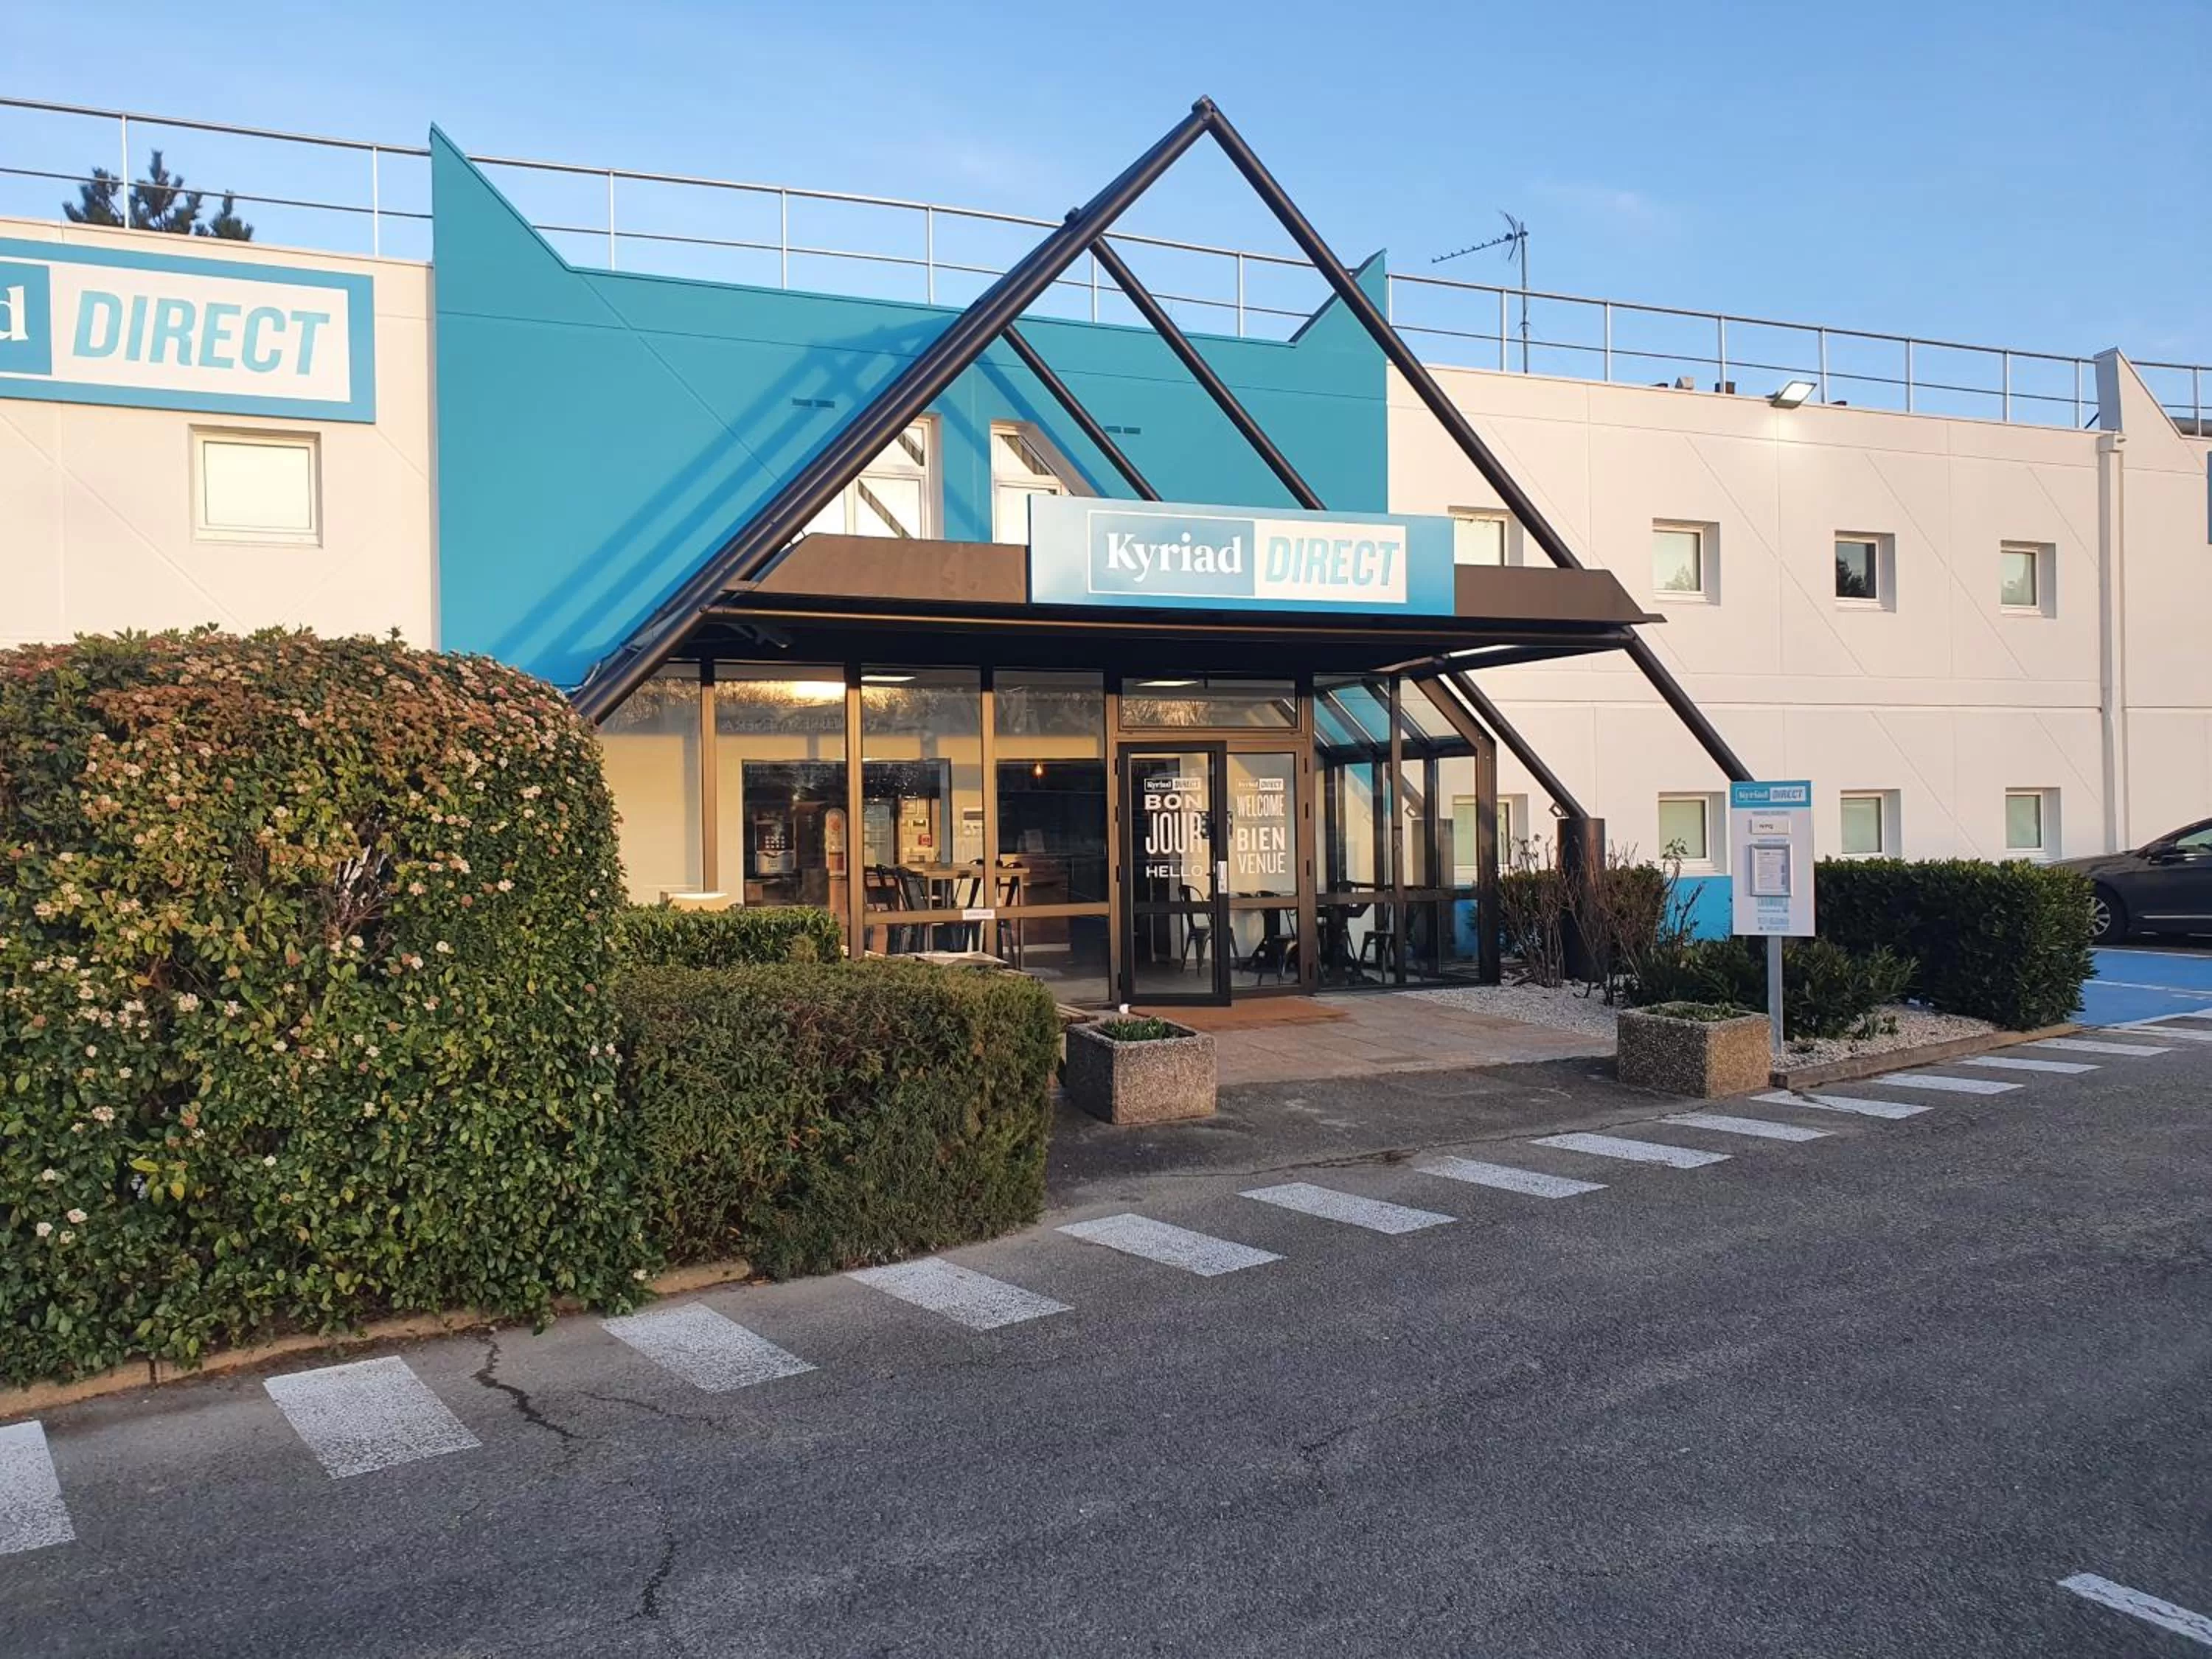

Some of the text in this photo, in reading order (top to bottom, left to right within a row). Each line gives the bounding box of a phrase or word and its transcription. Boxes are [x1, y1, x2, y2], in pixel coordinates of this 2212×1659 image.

[72, 290, 330, 376] DIRECT
[1106, 532, 1400, 587] Kyriad DIRECT
[1144, 794, 1203, 810] BON
[1237, 794, 1285, 817] WELCOME
[1773, 789, 1803, 799] DIRECT
[1145, 812, 1203, 854] JOUR
[1237, 827, 1285, 852] BIEN
[1145, 865, 1203, 878] HELLO
[1237, 852, 1286, 874] VENUE
